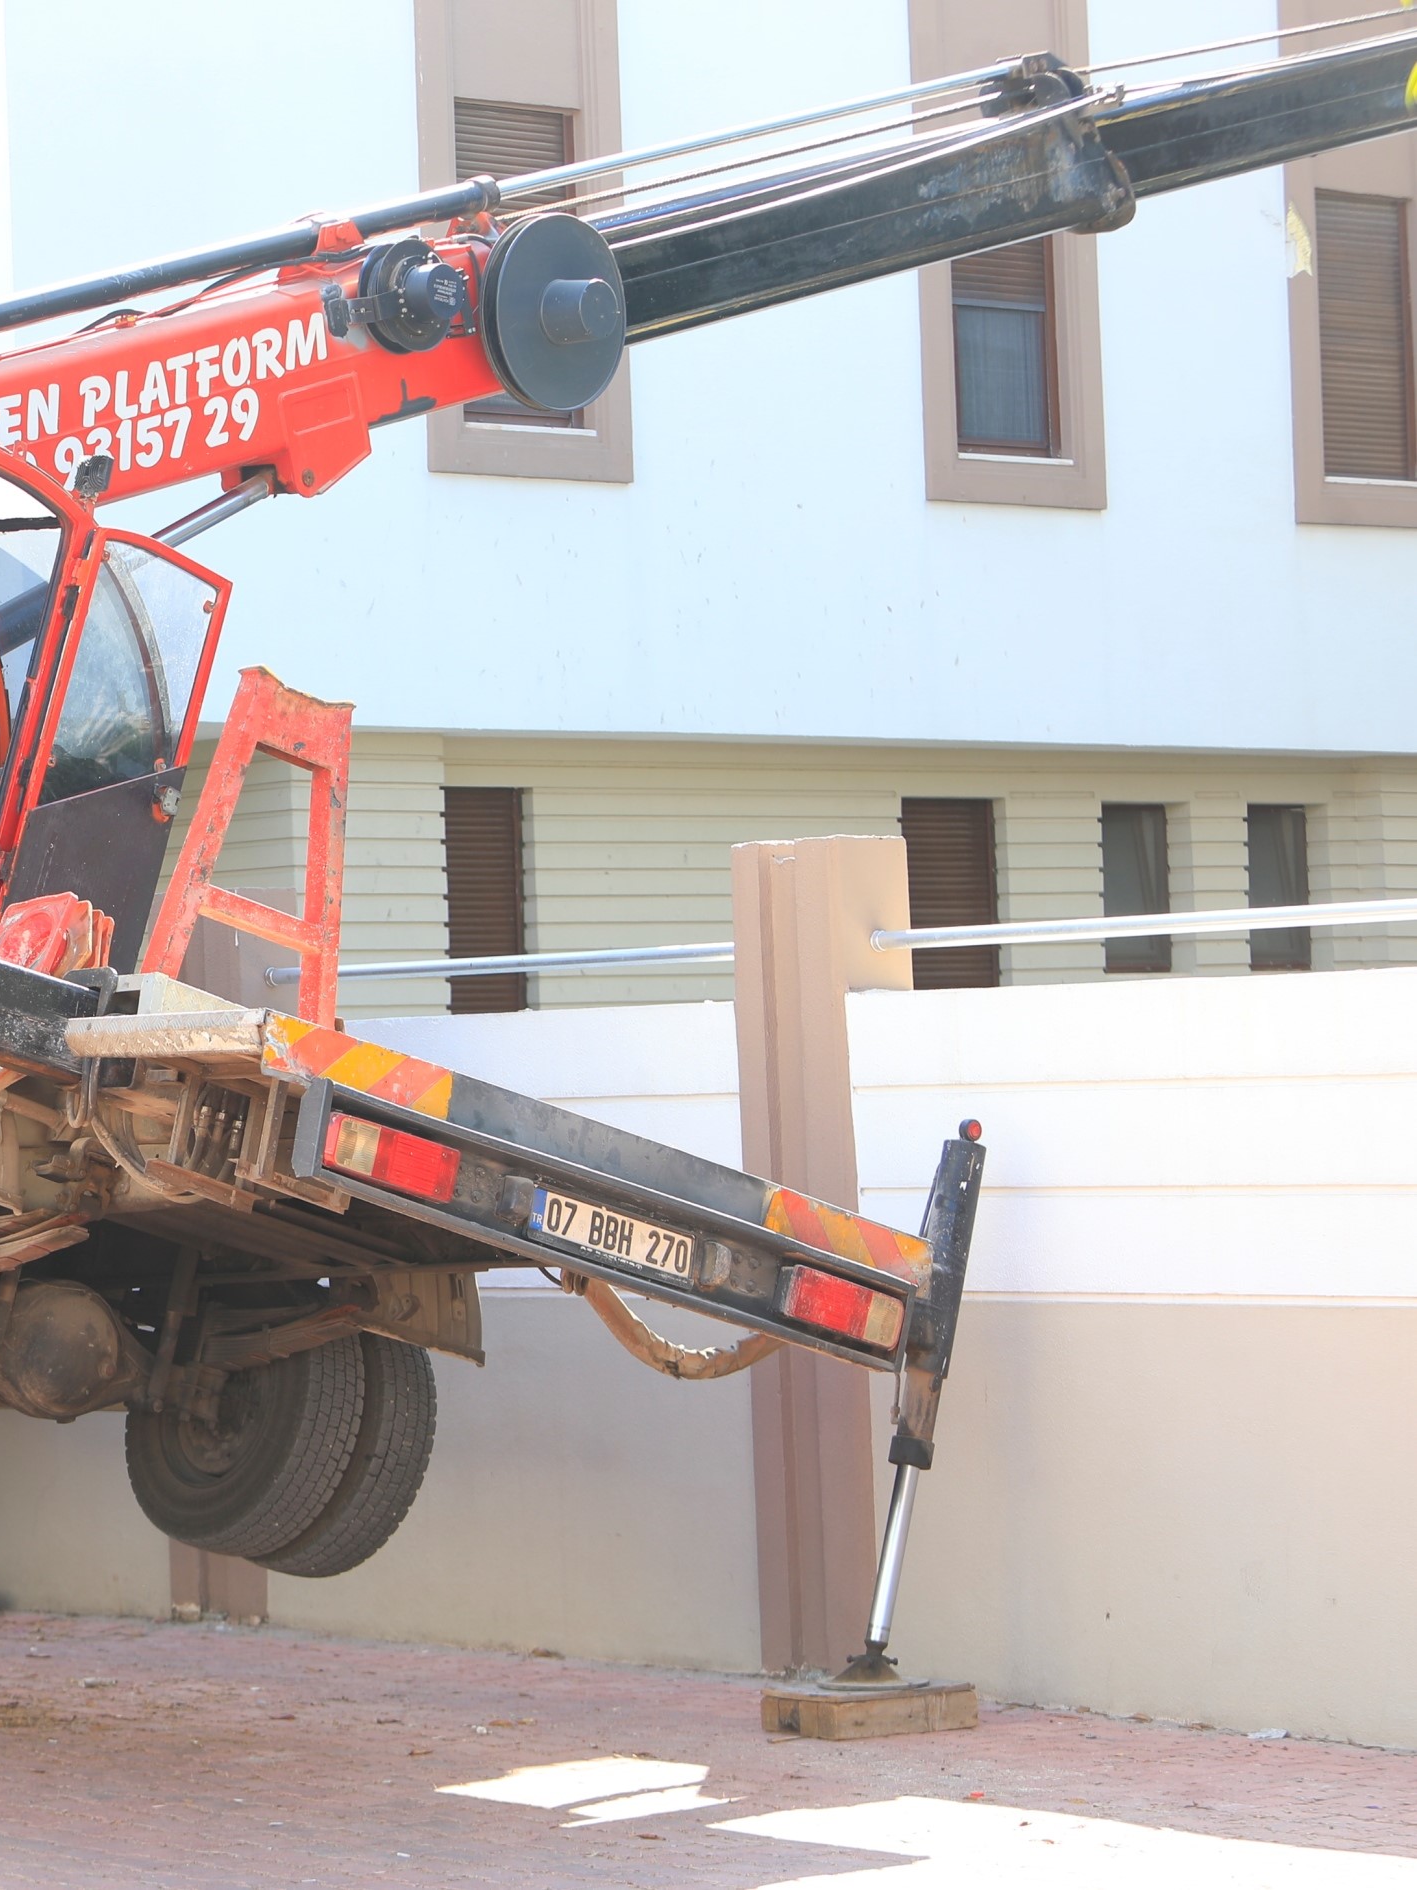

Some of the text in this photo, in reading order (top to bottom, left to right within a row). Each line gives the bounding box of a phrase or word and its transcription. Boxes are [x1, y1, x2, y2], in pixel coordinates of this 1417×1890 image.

[79, 312, 328, 428] PLATFORM
[203, 388, 260, 447] 29
[532, 1212, 543, 1224] TR
[547, 1198, 578, 1235] 07
[588, 1210, 635, 1256] BBH
[645, 1230, 688, 1273] 270
